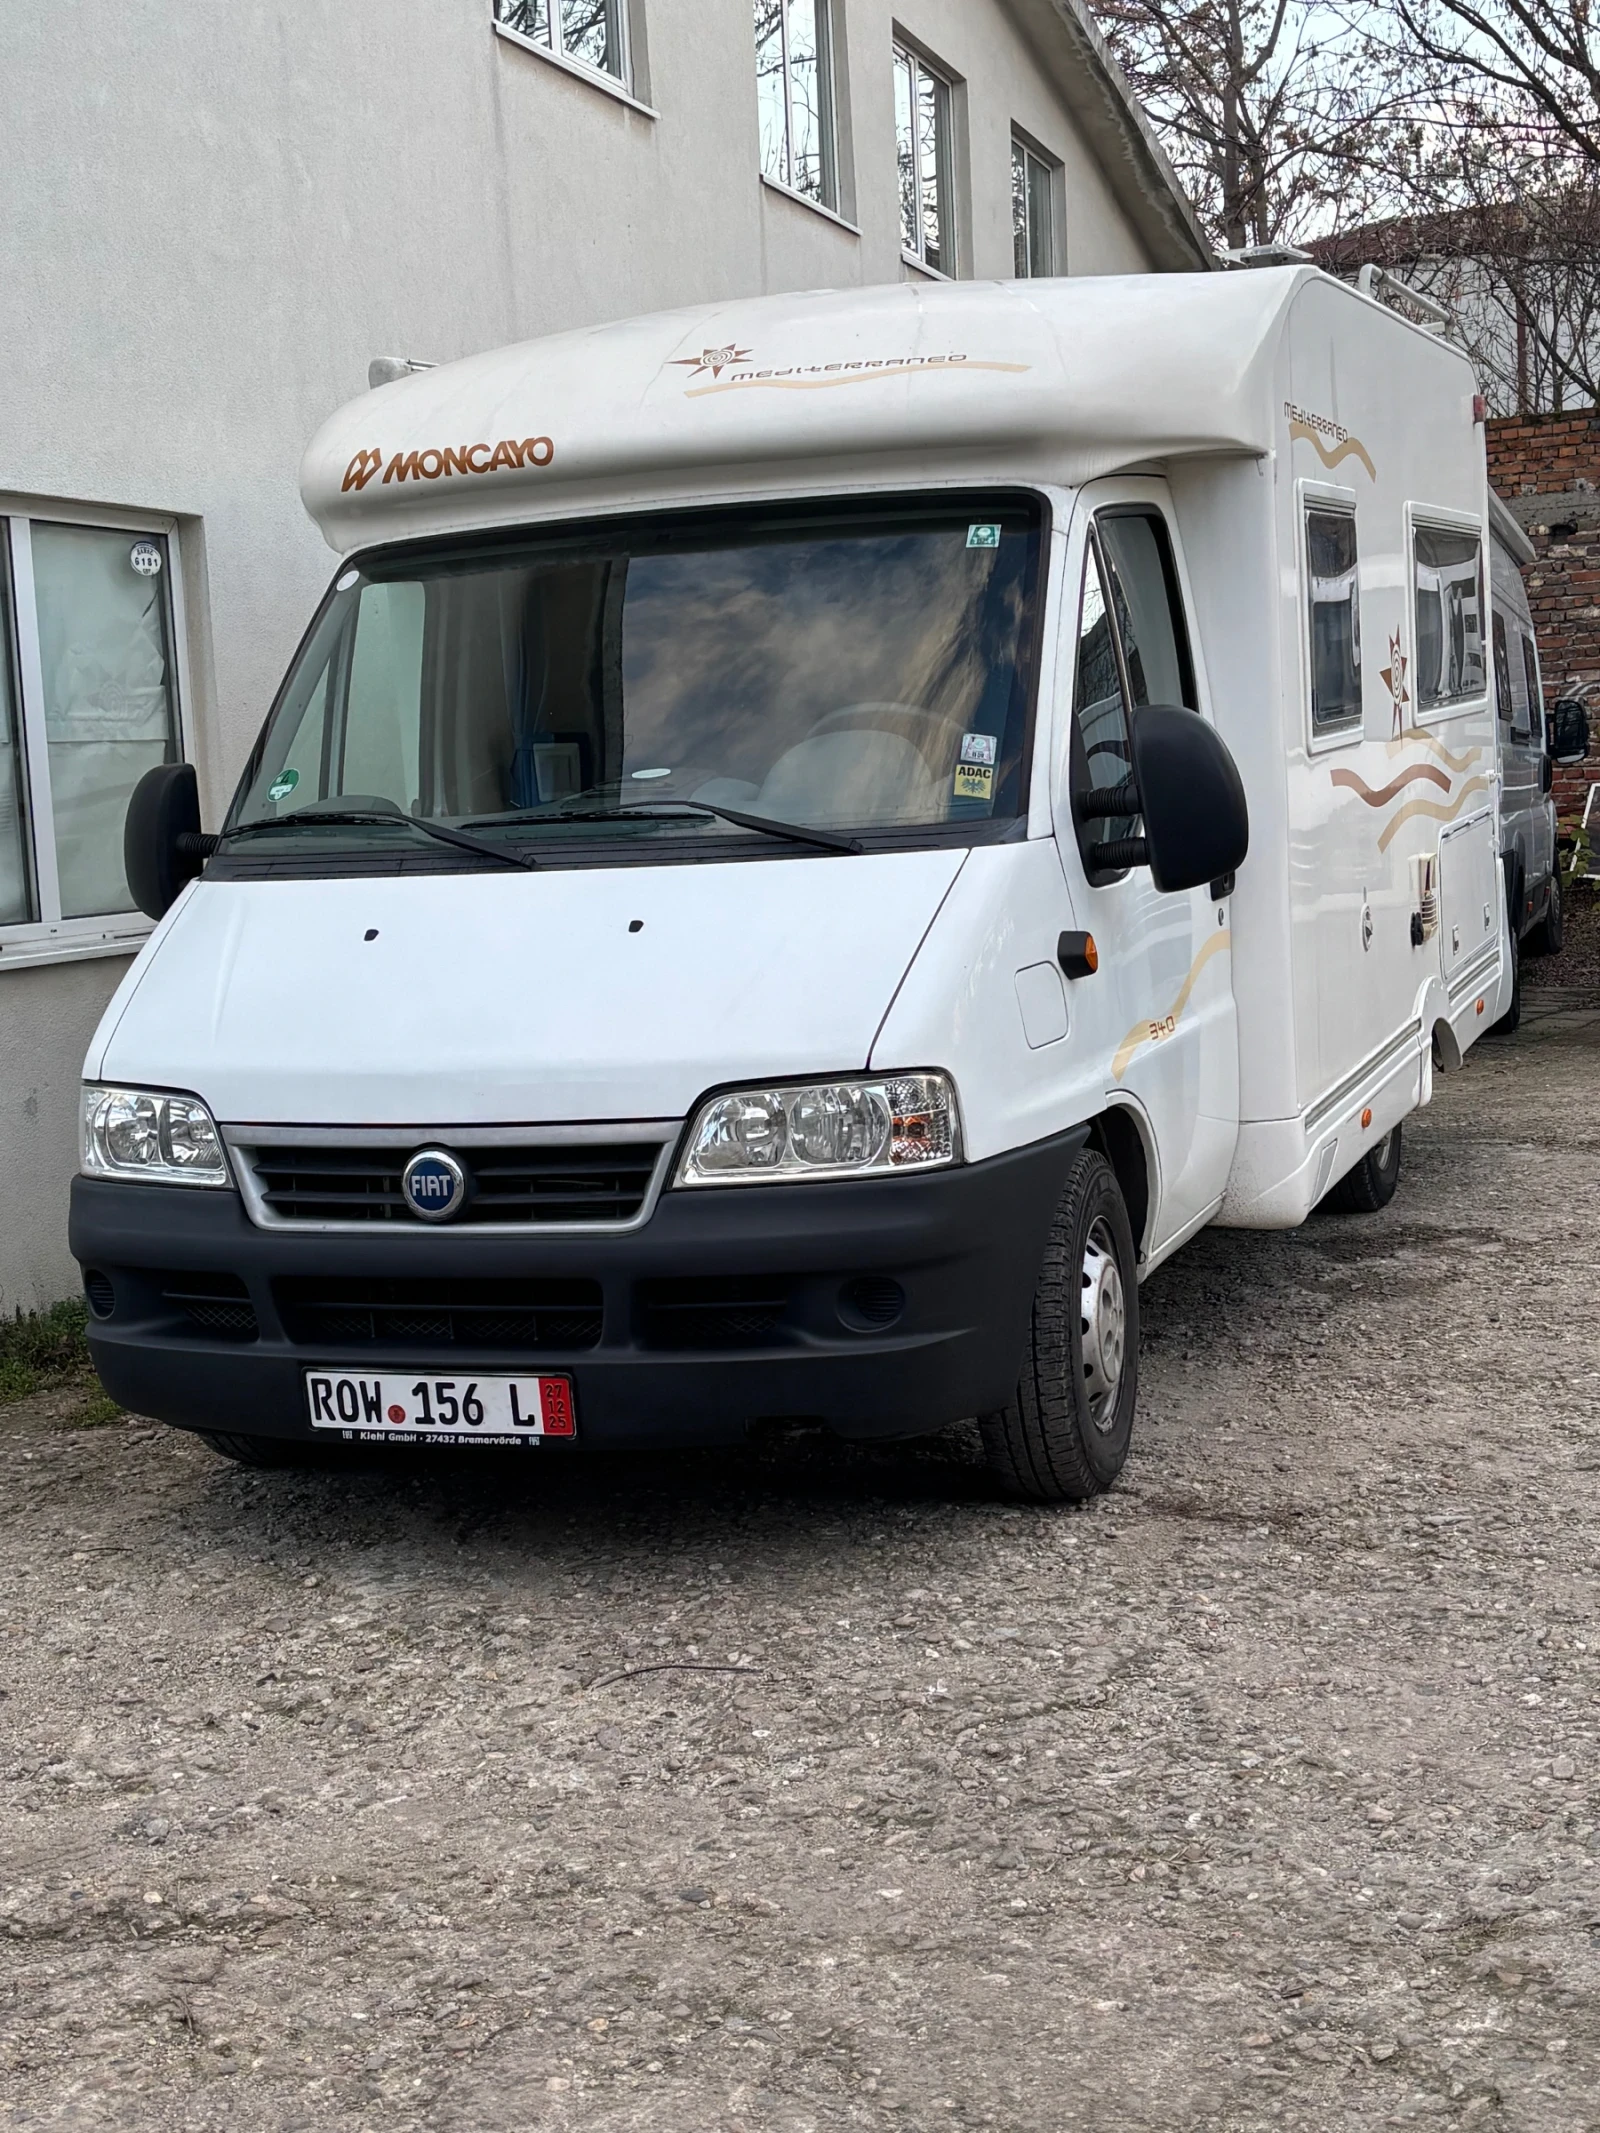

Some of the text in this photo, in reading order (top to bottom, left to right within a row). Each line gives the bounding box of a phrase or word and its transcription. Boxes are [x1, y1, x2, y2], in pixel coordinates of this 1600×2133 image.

[382, 436, 554, 484] MONCAYO
[958, 766, 991, 779] ADAC
[1149, 1015, 1175, 1040] 340
[411, 1175, 451, 1197] FIAT
[545, 1383, 562, 1398] 27
[310, 1378, 535, 1426] ROW 156 L
[547, 1399, 565, 1414] 12
[549, 1414, 566, 1429] 25
[360, 1431, 522, 1445] Kiehl GmbH 27432 Bremervörde
